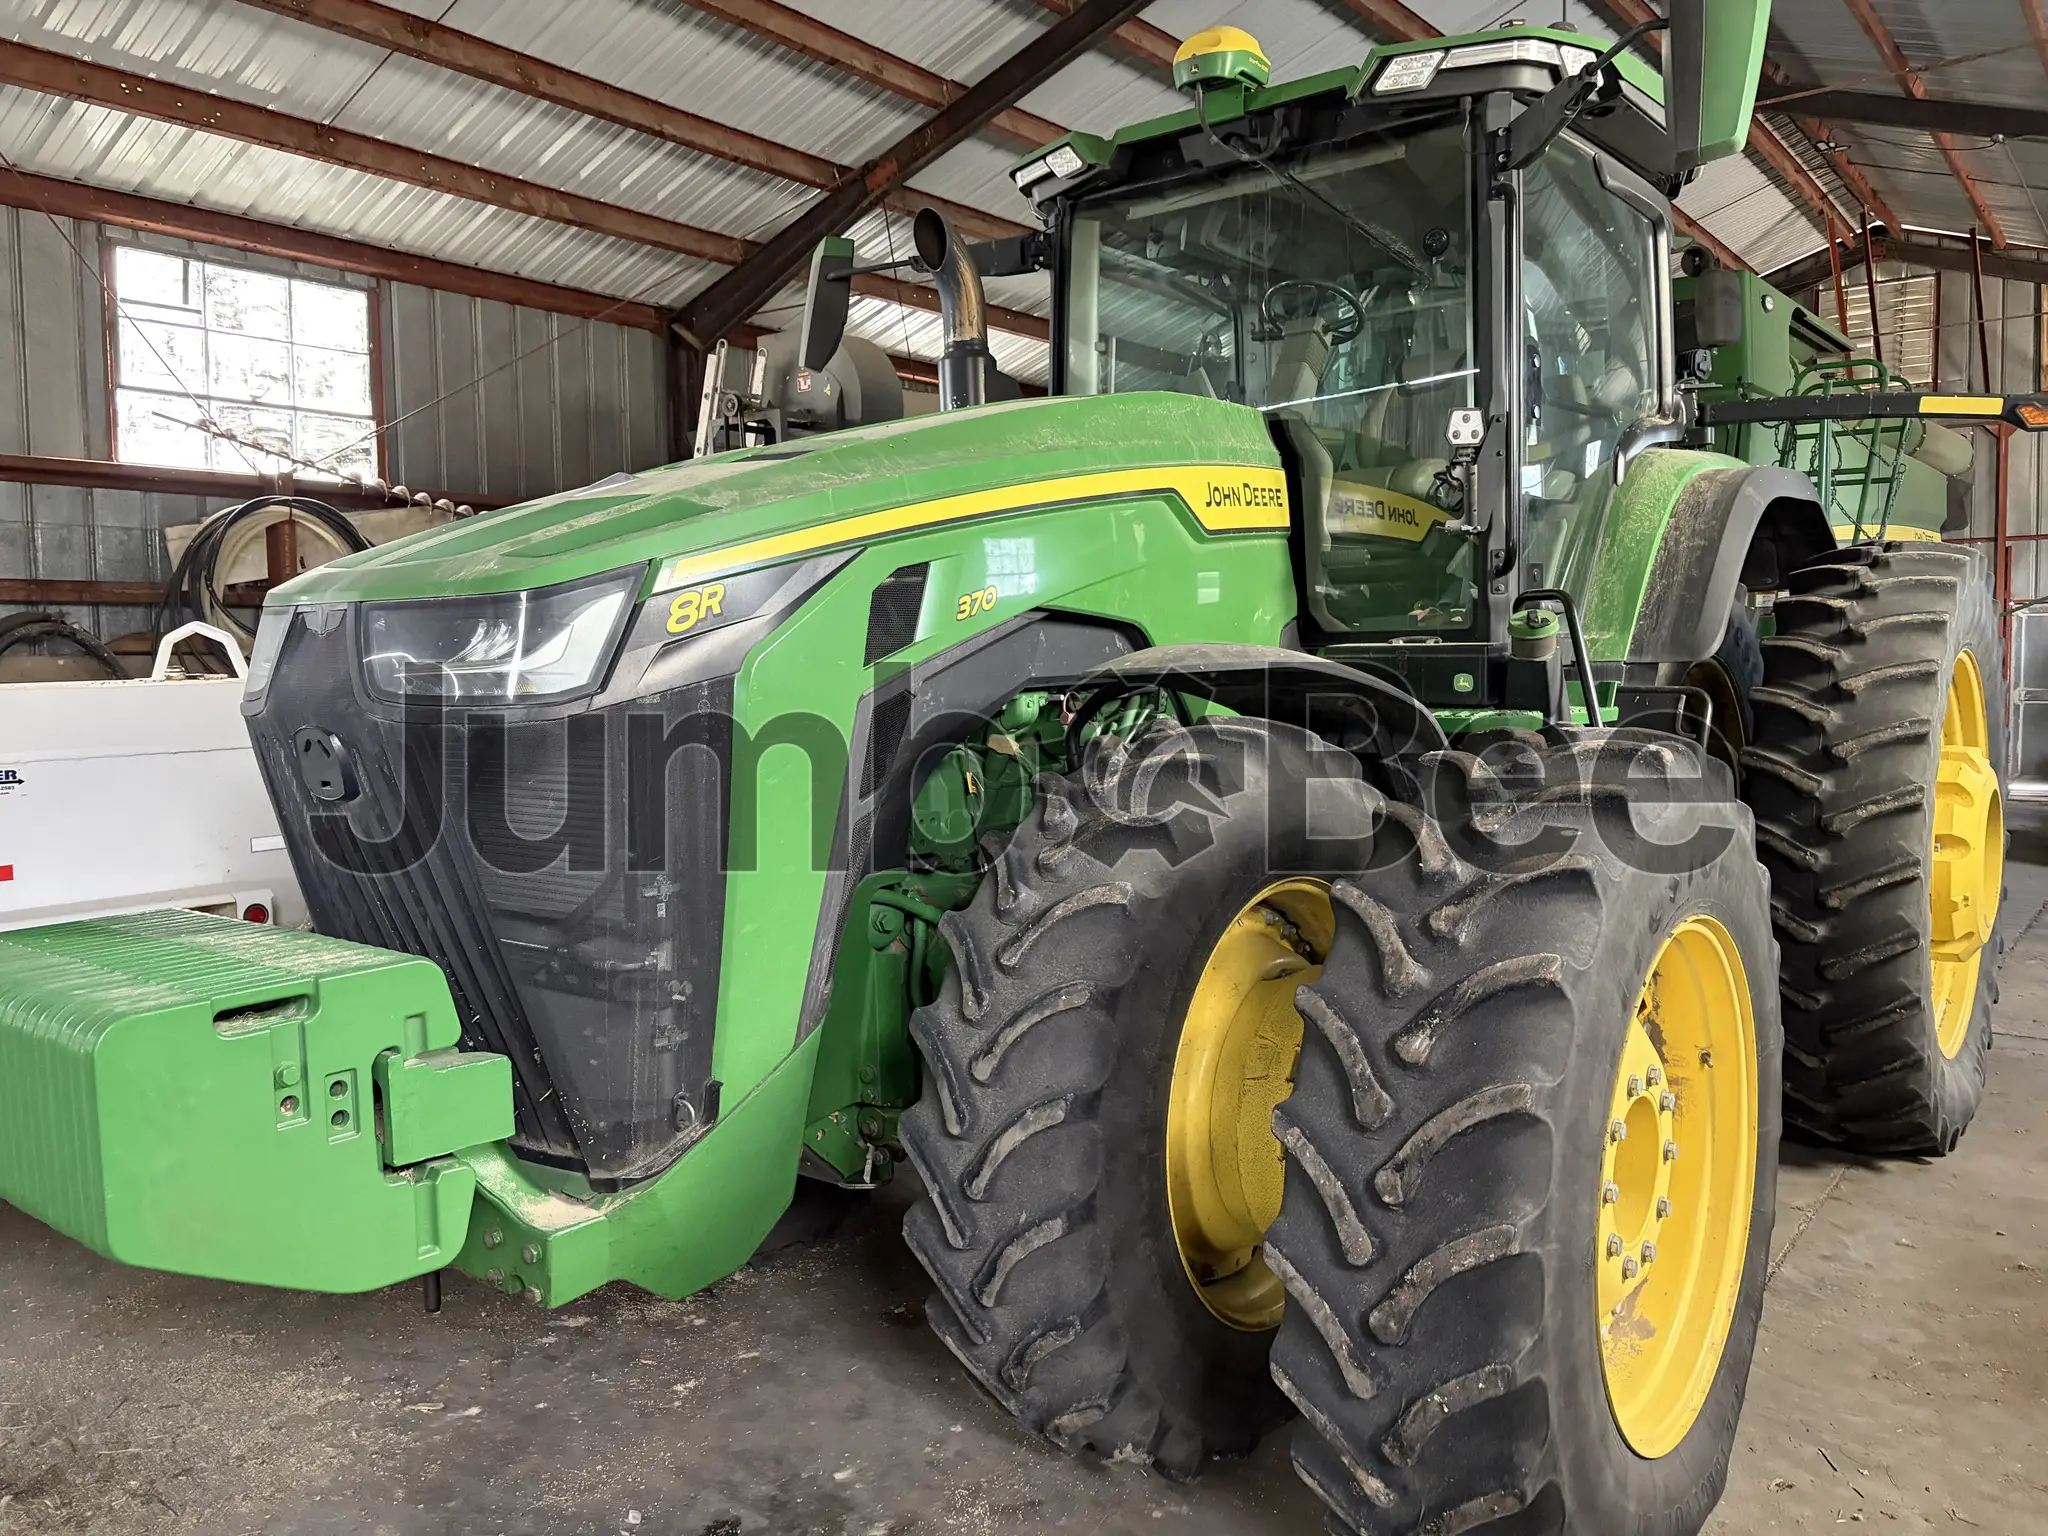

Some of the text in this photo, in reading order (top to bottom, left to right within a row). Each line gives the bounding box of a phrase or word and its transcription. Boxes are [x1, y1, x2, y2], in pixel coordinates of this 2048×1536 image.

[1206, 481, 1283, 508] JOHN DEERE
[666, 583, 726, 634] 8R
[956, 584, 998, 622] 370
